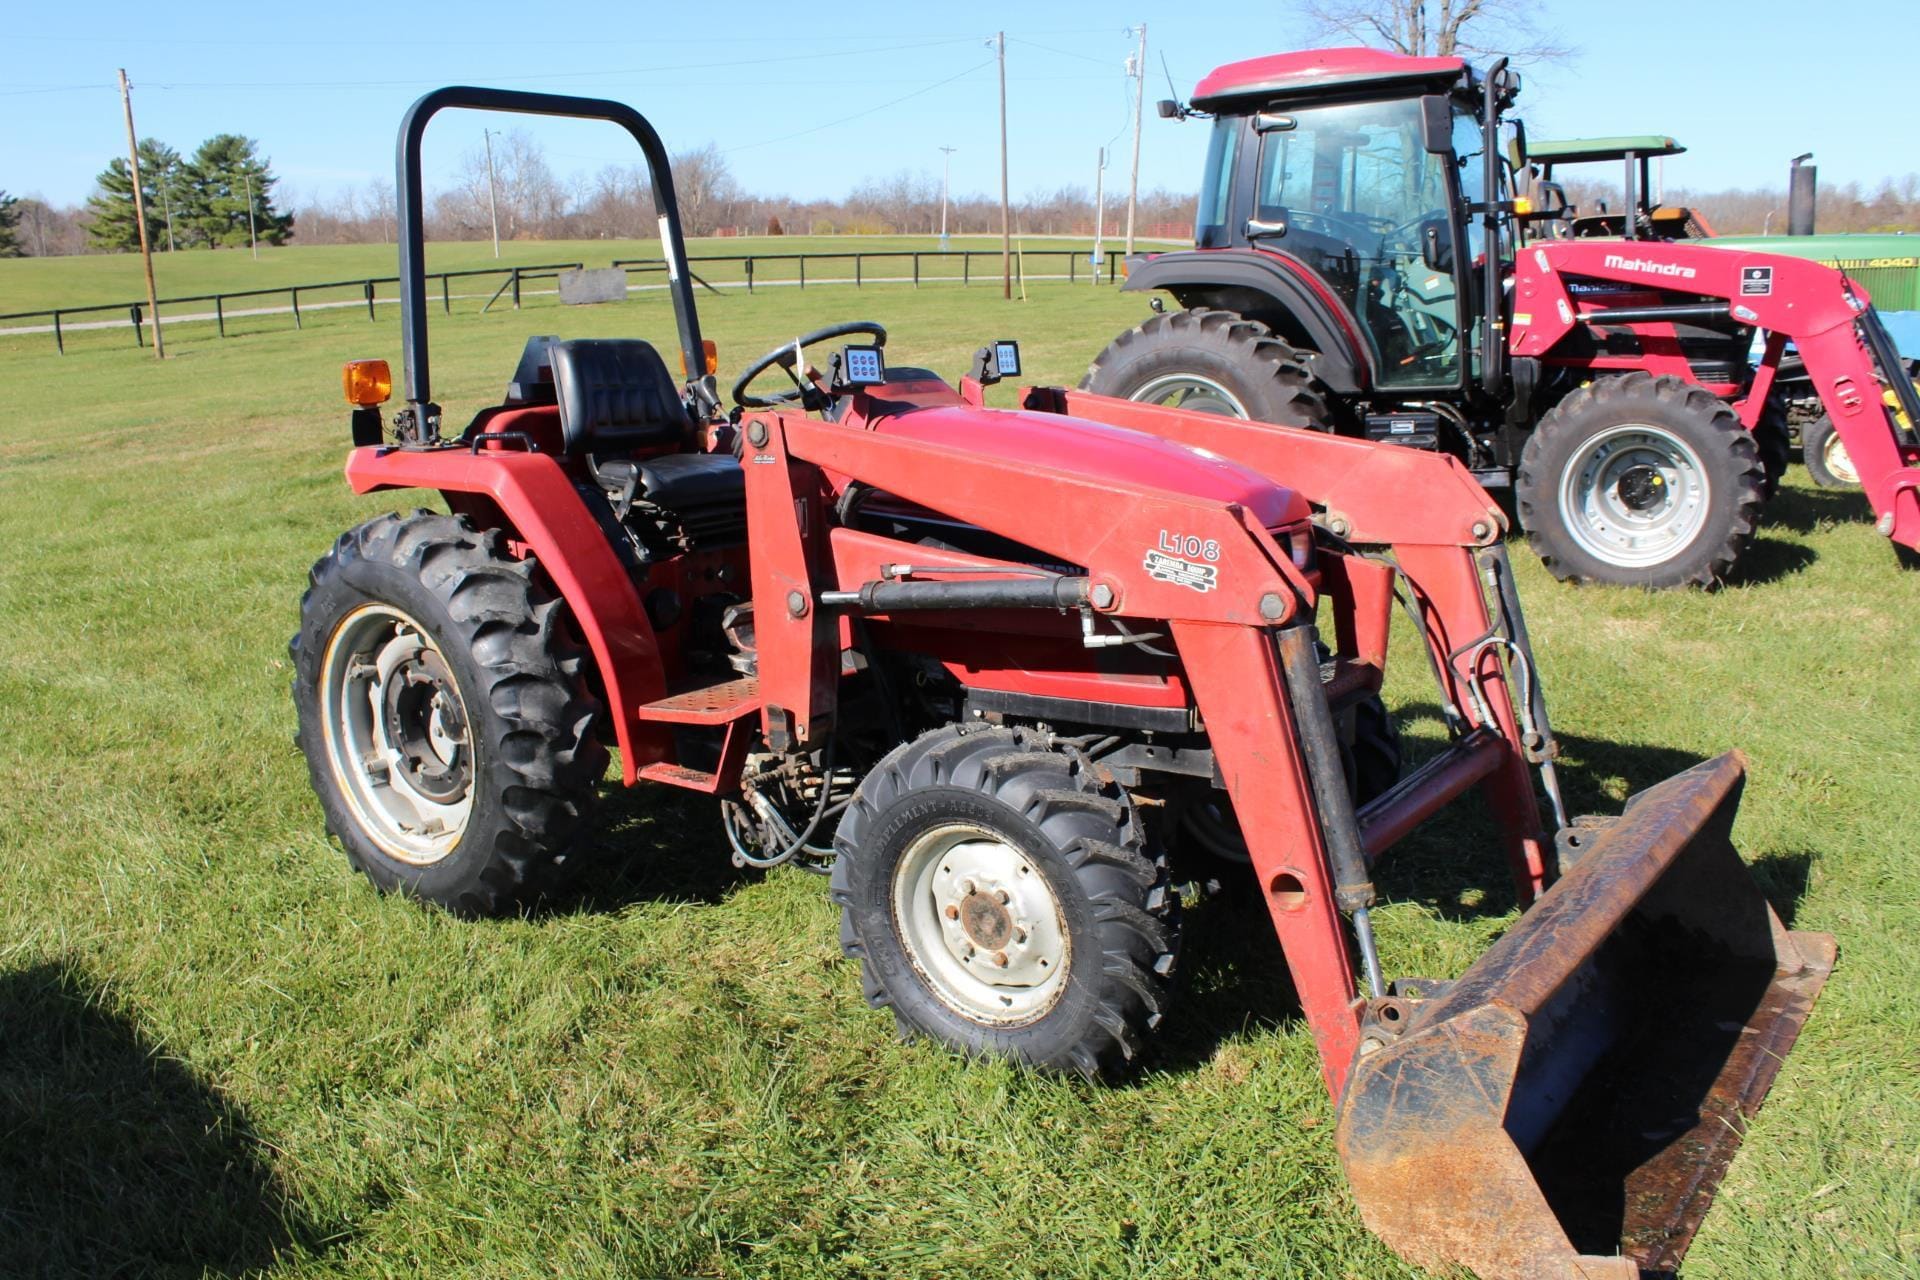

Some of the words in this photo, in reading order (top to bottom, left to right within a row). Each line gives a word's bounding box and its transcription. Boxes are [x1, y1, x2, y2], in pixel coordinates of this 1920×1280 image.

[1604, 254, 1696, 279] Mahindra
[1869, 257, 1912, 268] 4040
[1159, 529, 1221, 562] L108
